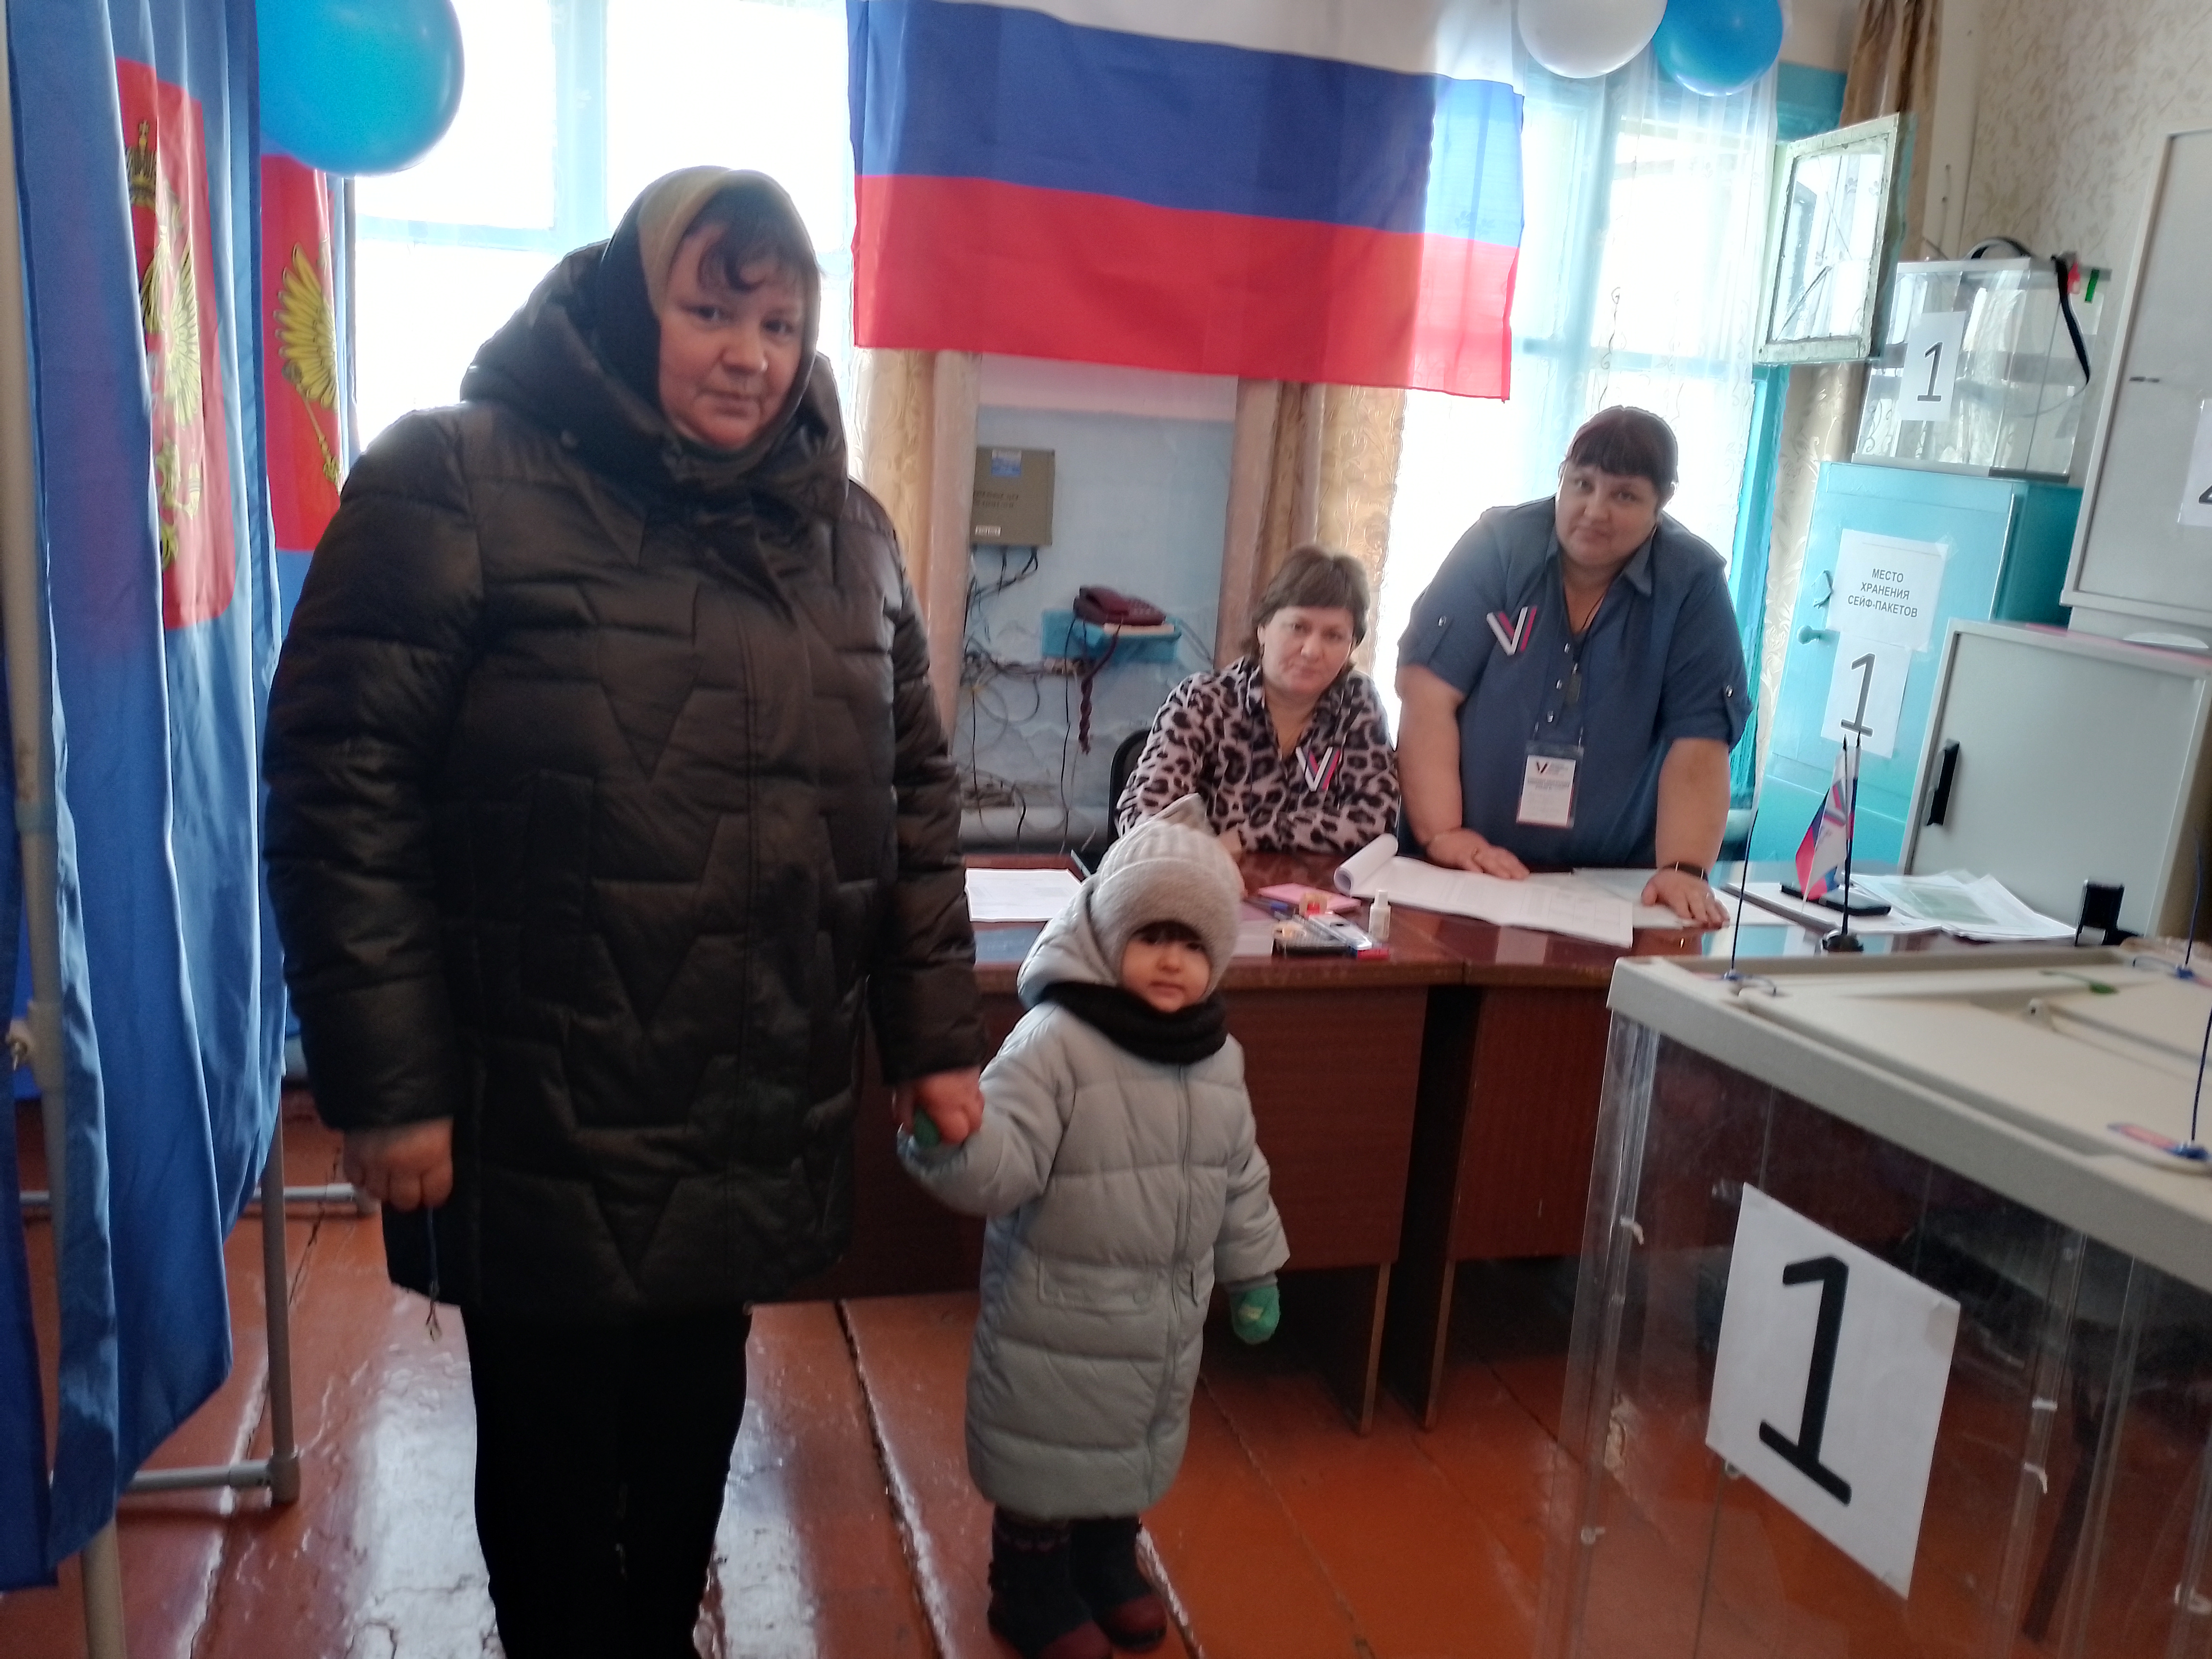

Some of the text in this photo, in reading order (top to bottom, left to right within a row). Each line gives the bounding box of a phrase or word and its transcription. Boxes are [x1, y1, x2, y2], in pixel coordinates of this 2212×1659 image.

[1916, 342, 1943, 402] 1
[1860, 582, 1910, 600] ХРАНЕНИЯ
[1872, 568, 1904, 583] МЕСТО
[1847, 595, 1918, 618] СЕЙФ-ПАКЕТОВ
[1840, 653, 1875, 737] 1
[1758, 1255, 1852, 1506] 1
